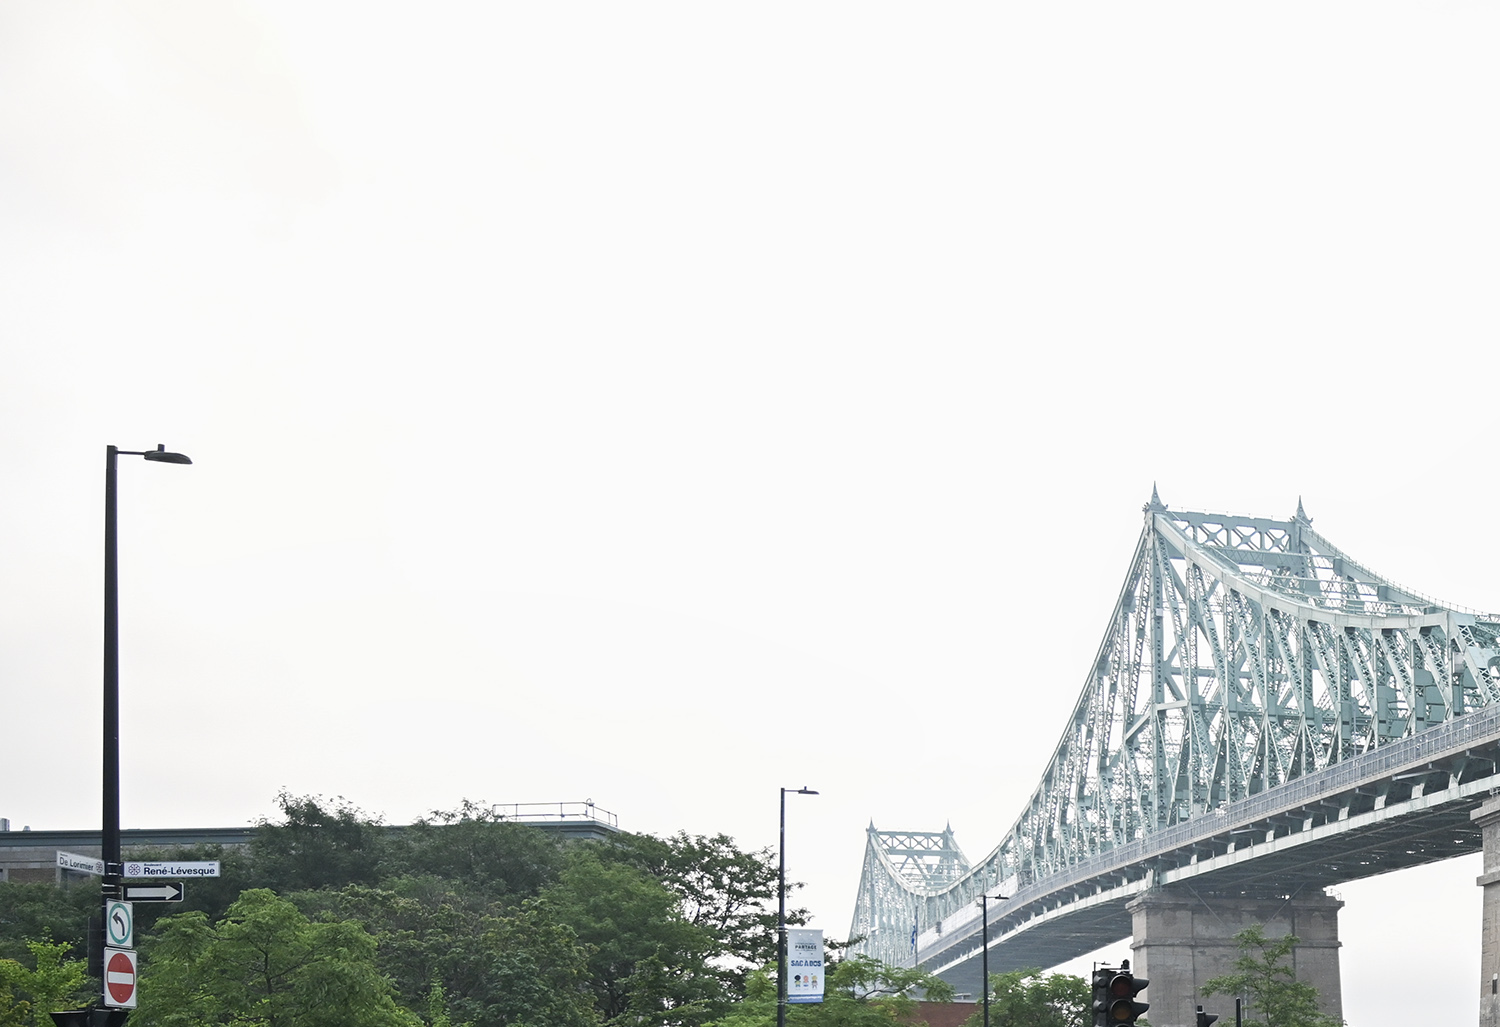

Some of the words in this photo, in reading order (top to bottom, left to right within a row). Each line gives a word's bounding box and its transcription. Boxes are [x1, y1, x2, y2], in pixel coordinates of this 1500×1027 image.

[60, 856, 68, 866] De
[70, 859, 94, 870] Lorimier
[144, 866, 215, 876] René-Lévesque
